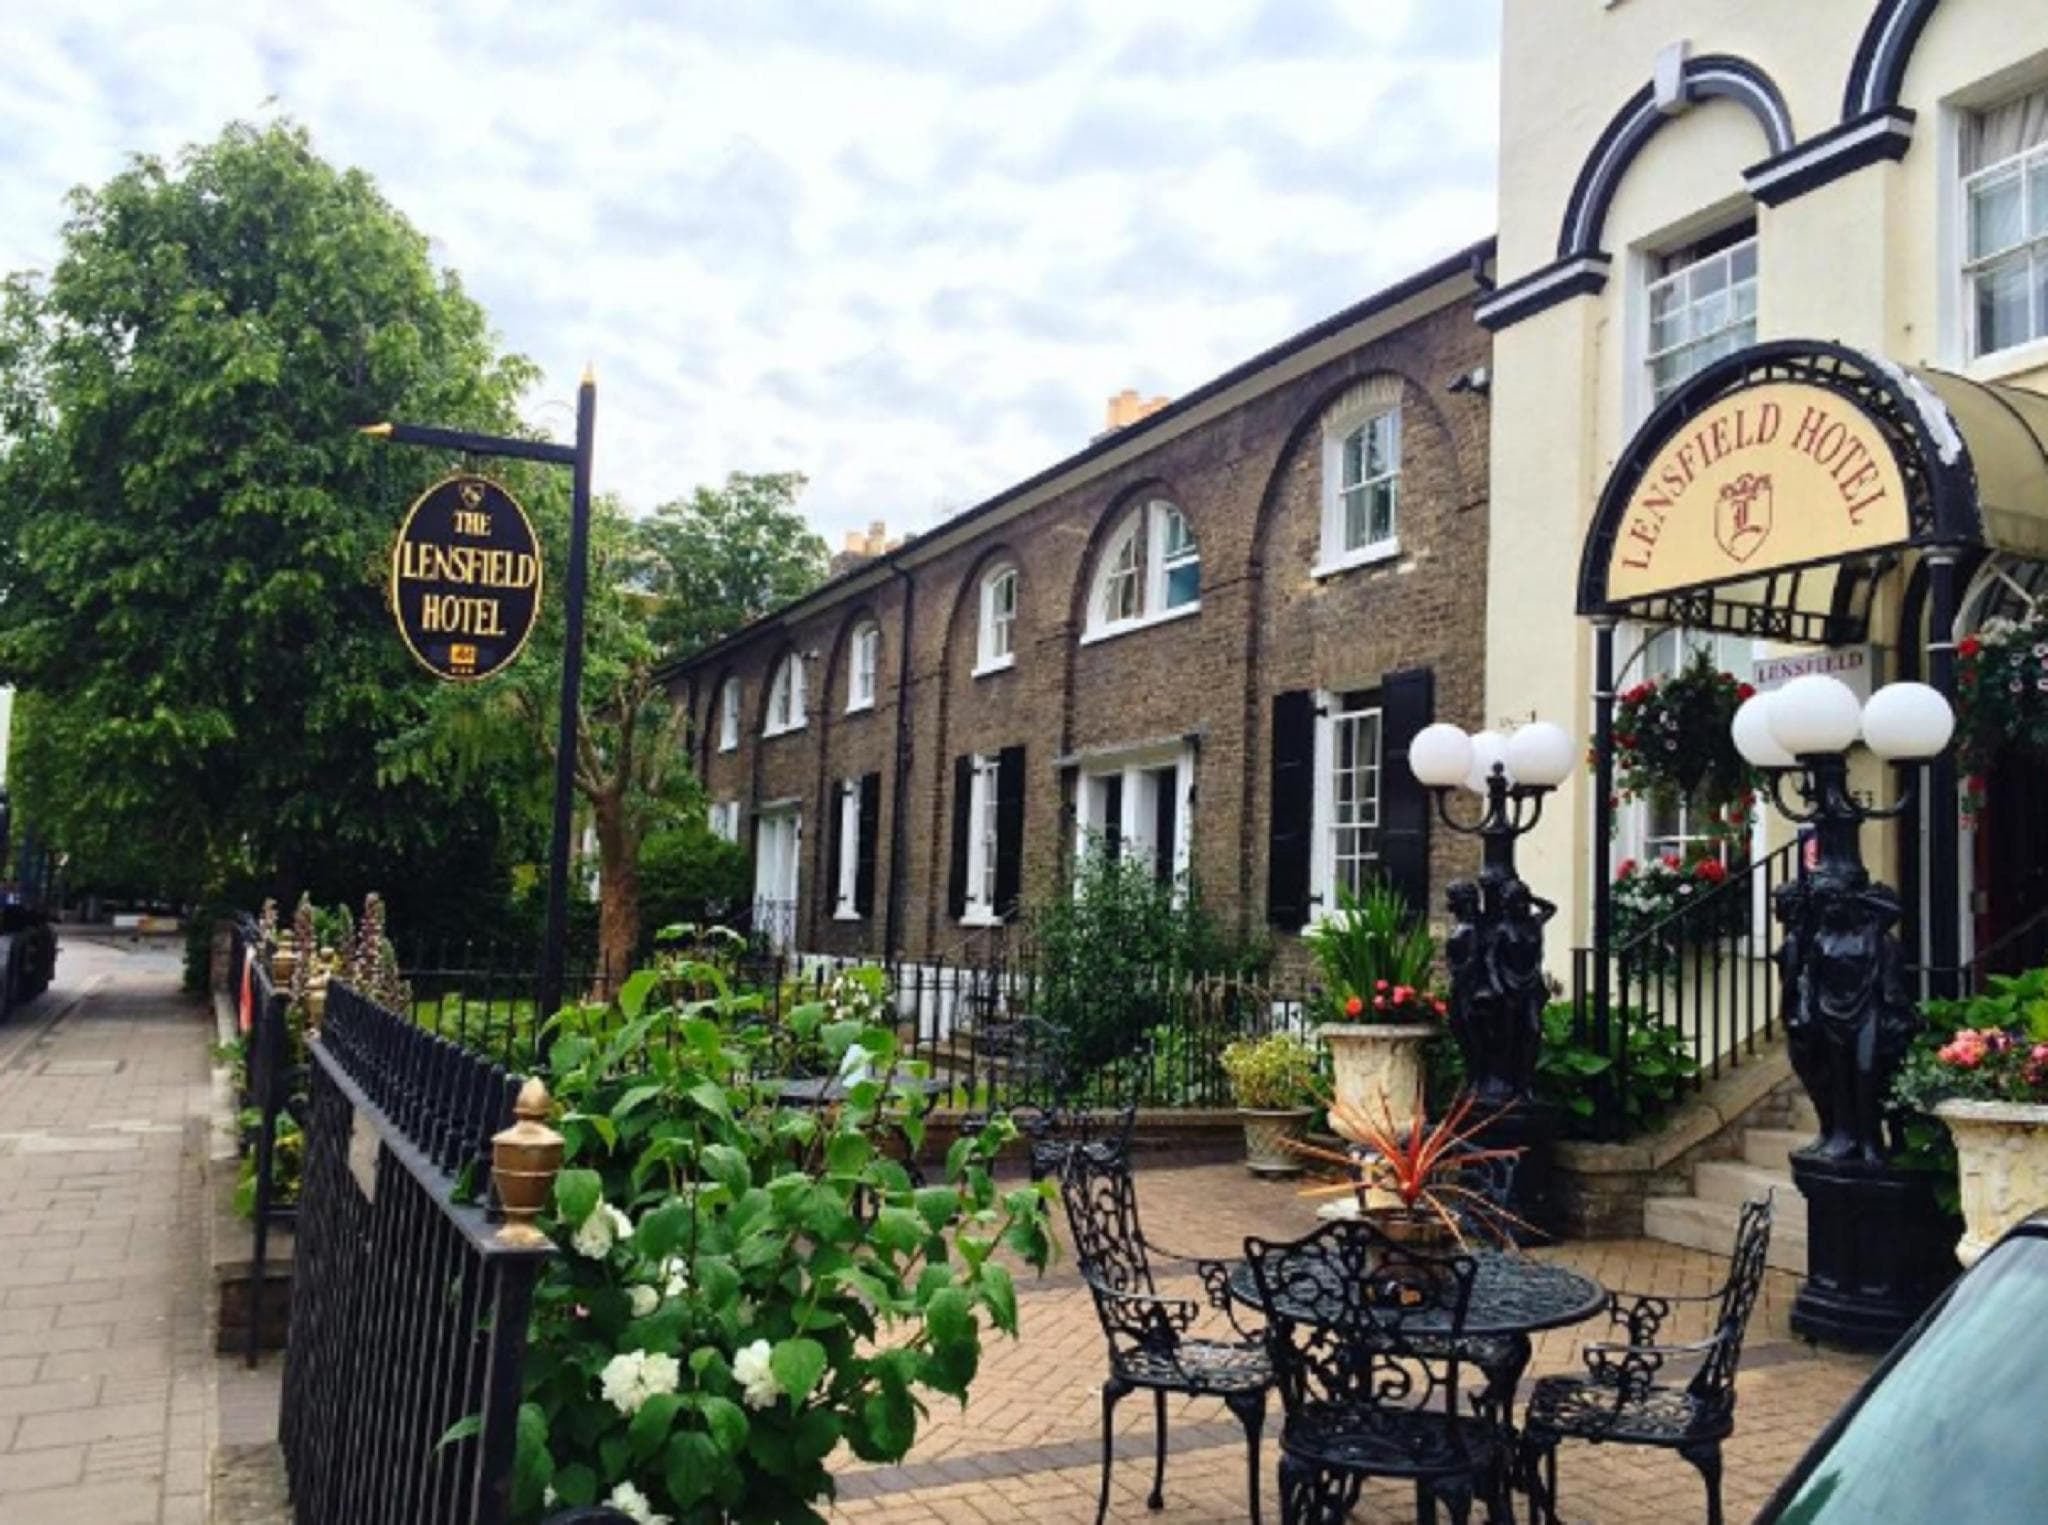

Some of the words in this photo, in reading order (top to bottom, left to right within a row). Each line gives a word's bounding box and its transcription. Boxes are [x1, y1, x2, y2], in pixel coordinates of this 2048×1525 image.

[1621, 402, 1782, 572] LENSFIELD
[1791, 404, 1888, 526] HOTEL
[453, 511, 492, 536] THE
[401, 541, 535, 588] LENSFIELD
[421, 593, 507, 636] HOTEL
[1757, 652, 1864, 683] LENSFIELD
